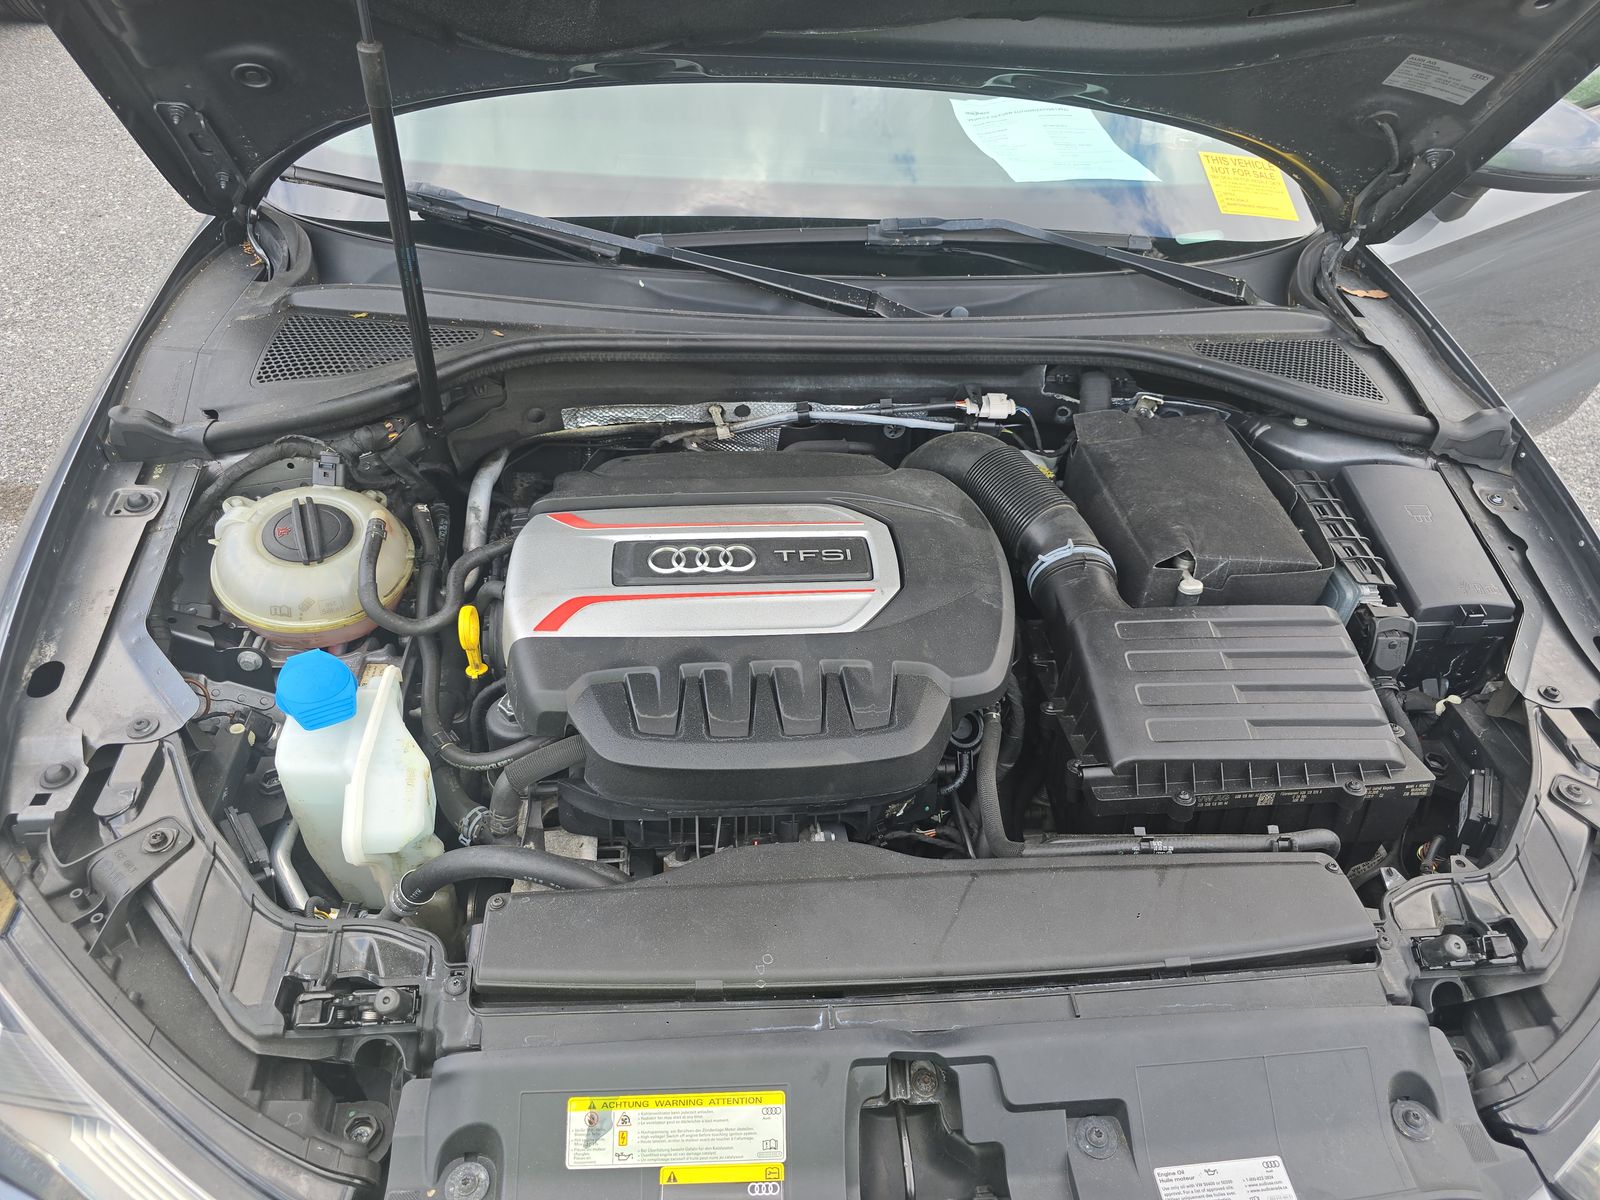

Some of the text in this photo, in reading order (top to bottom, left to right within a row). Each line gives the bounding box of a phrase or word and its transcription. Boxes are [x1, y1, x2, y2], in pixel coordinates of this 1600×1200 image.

[1204, 154, 1276, 172] THIS VEHICLE
[1210, 166, 1231, 175] NOT
[1231, 168, 1251, 177] FOR
[1252, 170, 1277, 181] SALE
[773, 549, 852, 562] TFSI
[600, 1096, 763, 1109] ACHTUNG WARNING ATTENTION
